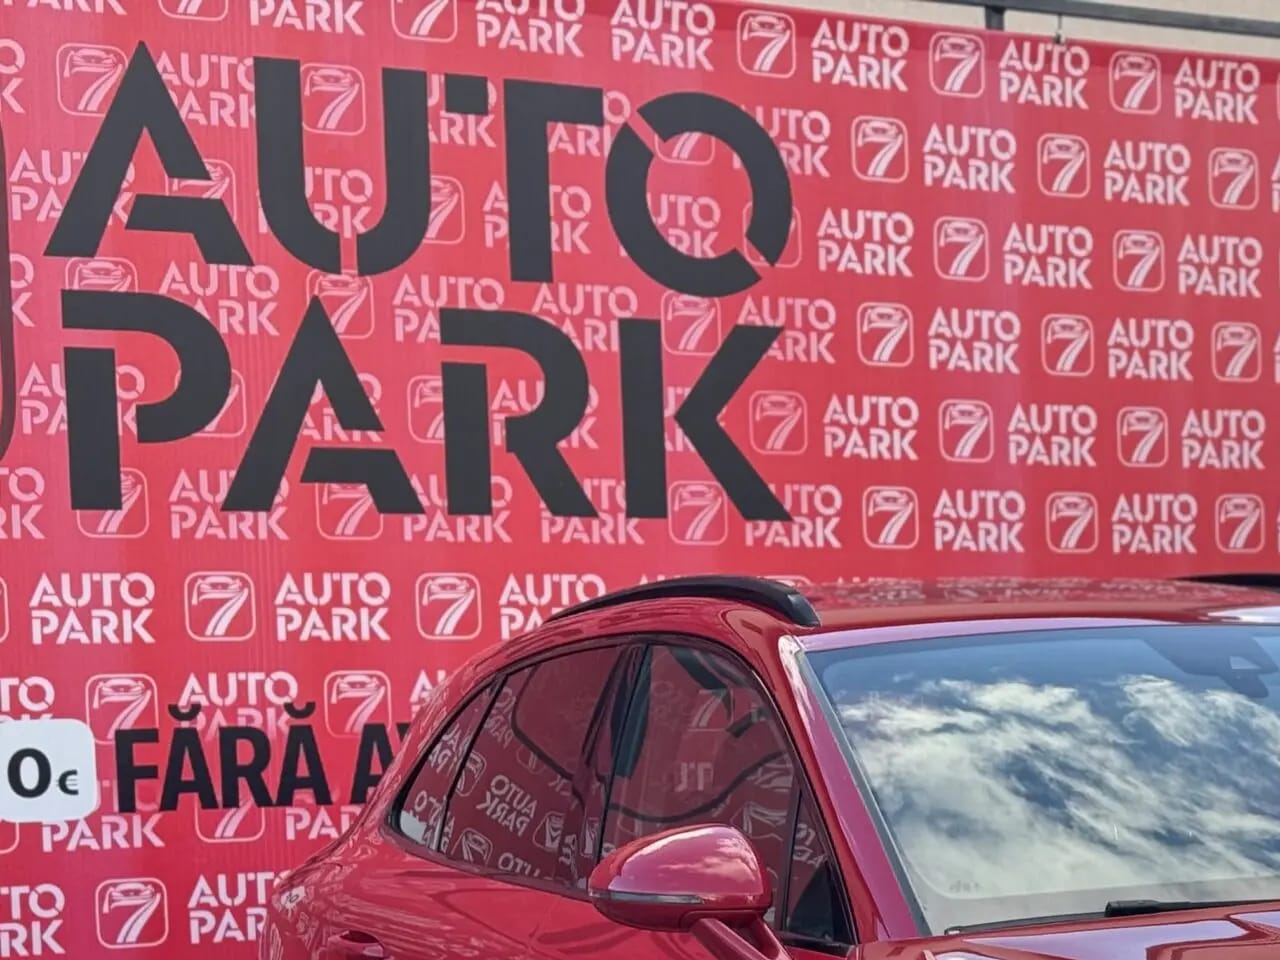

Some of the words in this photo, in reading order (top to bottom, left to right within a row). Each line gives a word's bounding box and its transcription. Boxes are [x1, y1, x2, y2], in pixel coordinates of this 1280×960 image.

[250, 0, 365, 36] PARK
[611, 0, 714, 35] AUTO
[477, 14, 583, 57] PARK
[612, 28, 712, 70] PARK
[812, 19, 908, 57] AUTO
[813, 51, 907, 91] PARK
[1000, 40, 1089, 76] AUTO
[1000, 71, 1088, 109] PARK
[1174, 60, 1259, 92] AUTO
[166, 90, 256, 129] ARK
[1175, 88, 1258, 124] PARK
[757, 105, 831, 143] UTO
[924, 124, 1016, 160] AUTO
[1104, 141, 1190, 174] AUTO
[43, 40, 794, 298] AUTO
[925, 155, 1014, 193] PARK
[1105, 171, 1189, 205] PARK
[647, 192, 721, 229] UTO
[818, 208, 913, 244] AUTO
[1003, 223, 1093, 257] AUTO
[1178, 235, 1262, 267] AUTO
[819, 240, 912, 276] PARK
[1004, 254, 1091, 288] PARK
[159, 262, 280, 301] AUTO
[393, 274, 504, 310] AUTO
[1179, 264, 1260, 297] PARK
[532, 282, 638, 318] AUTO
[736, 295, 836, 330] AUTO
[928, 308, 1020, 341] AUTO
[1108, 319, 1193, 349] AUTO
[930, 339, 1019, 374] PARK
[1109, 348, 1192, 380] PARK
[61, 289, 794, 522] PARK
[824, 395, 919, 427] AUTO
[1008, 404, 1097, 435] AUTO
[1182, 410, 1265, 439] AUTO
[825, 427, 917, 460] PARK
[1009, 434, 1096, 466] PARK
[1182, 439, 1263, 469] PARK
[769, 484, 842, 516] UTO
[934, 490, 1025, 521] AUTO
[1112, 494, 1197, 523] AUTO
[171, 505, 290, 540] PARK
[403, 509, 513, 544] PARK
[540, 510, 645, 544] PARK
[745, 516, 842, 549] PARK
[935, 520, 1024, 552] PARK
[1113, 524, 1196, 553] PARK
[30, 573, 154, 606] AUTO
[275, 573, 390, 605] AUTO
[499, 573, 606, 607] AUTO
[32, 609, 154, 644] PARK
[277, 608, 390, 640] PARK
[180, 671, 298, 707] AUTO
[113, 701, 332, 814] FĂRĂ
[42, 812, 165, 853] PARK
[0, 882, 65, 920] TO
[0, 919, 65, 958] RK
[189, 907, 268, 945] PAR
